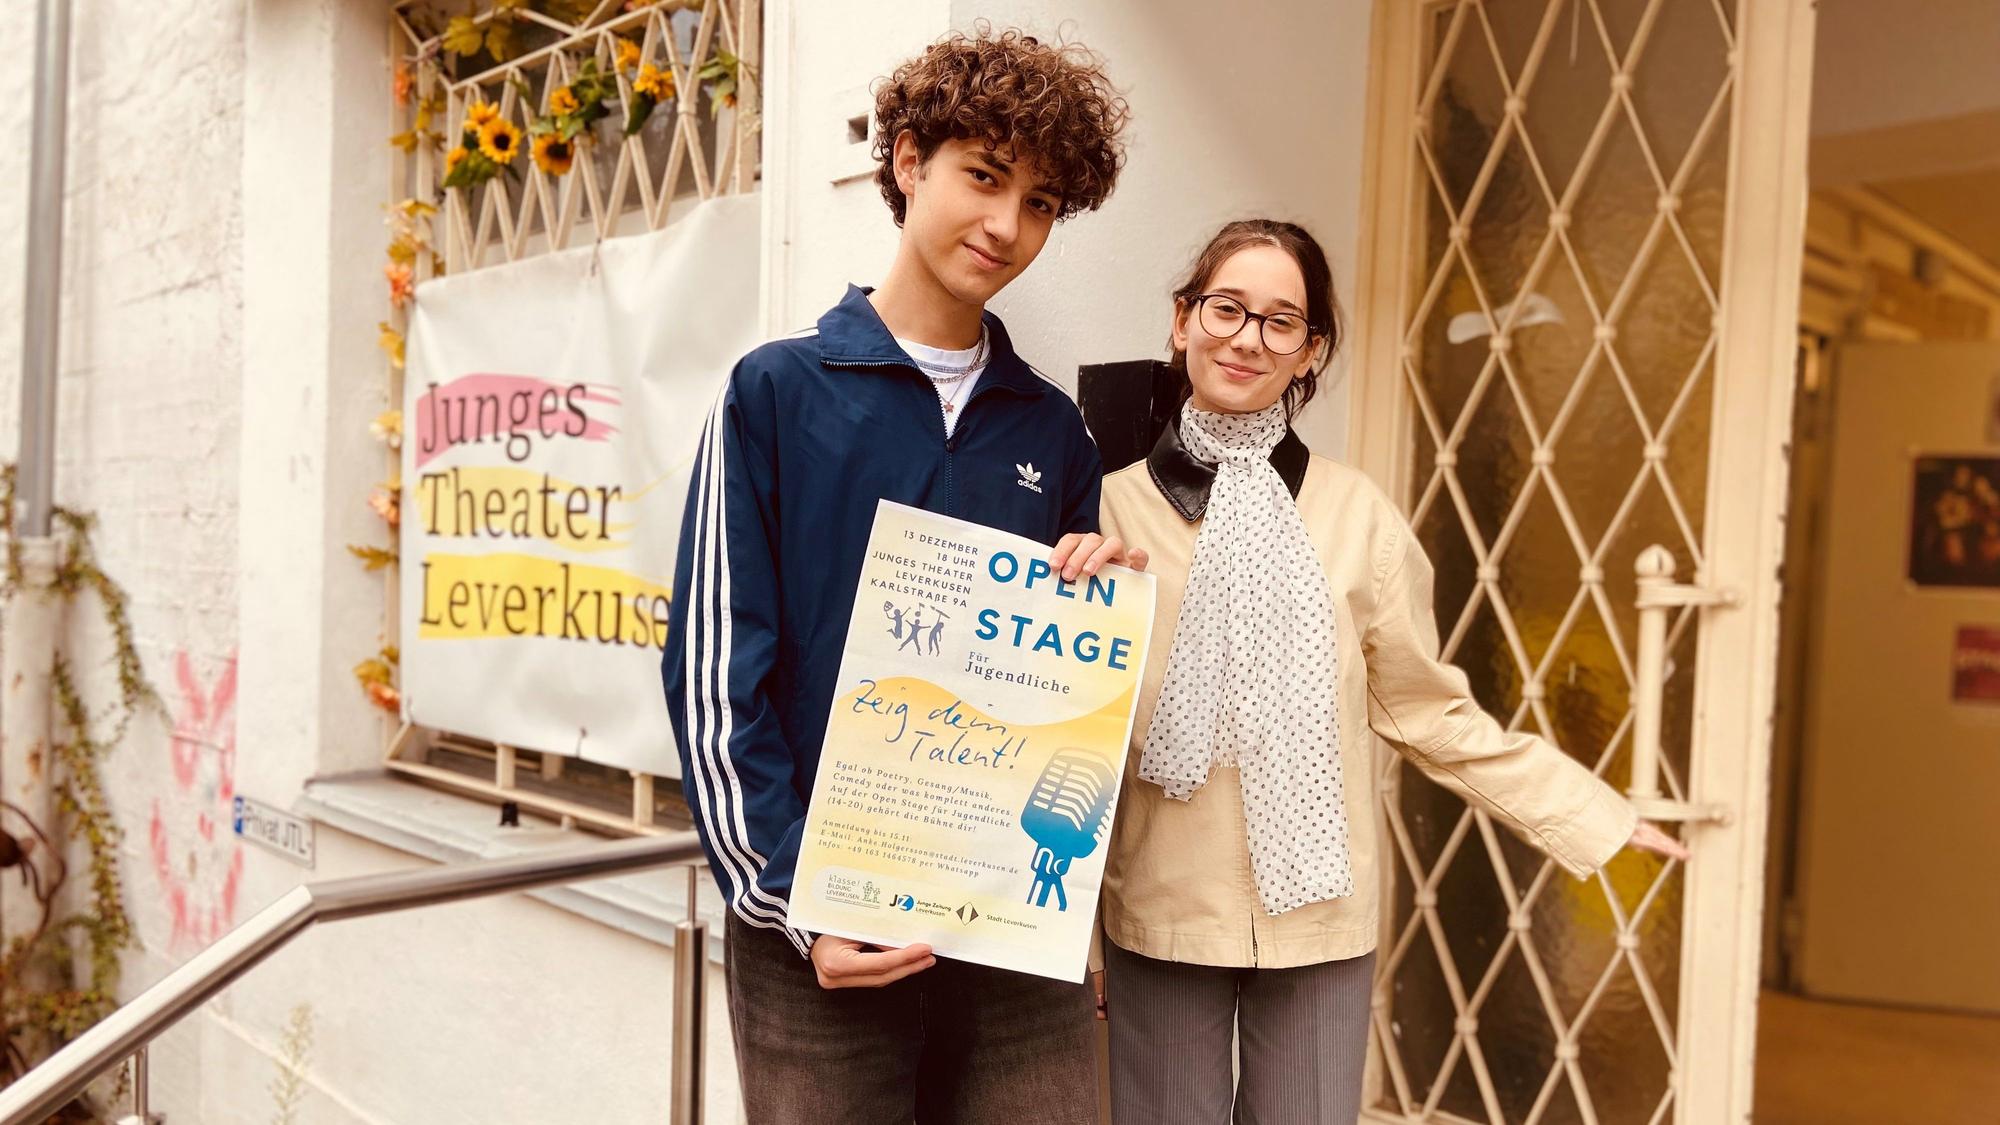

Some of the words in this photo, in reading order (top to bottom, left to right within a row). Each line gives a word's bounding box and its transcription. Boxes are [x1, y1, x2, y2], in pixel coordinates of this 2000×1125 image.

[422, 381, 588, 462] Junges
[1017, 479, 1043, 494] adidas
[421, 466, 623, 541] Theater
[904, 530, 915, 540] 13
[919, 534, 978, 556] DEZEMBER
[872, 551, 916, 568] JUNGES
[922, 562, 973, 582] THEATER
[937, 552, 948, 562] 18
[953, 557, 976, 569] UHR
[870, 578, 948, 603] KARLSTRAßE
[953, 597, 967, 608] 9A
[895, 570, 971, 595] LEVERKUSEN
[988, 551, 1116, 607] OPEN
[420, 561, 672, 653] Leverkuse
[975, 608, 1132, 671] STAGE
[968, 651, 990, 664] Für
[965, 661, 1071, 694] Jugendliche
[852, 679, 909, 743] Zeig
[928, 700, 1007, 735] dein
[910, 730, 1028, 770] Talent!
[833, 772, 872, 788] Comedy
[875, 782, 898, 792] oder
[902, 788, 920, 797] was
[923, 791, 968, 807] komplett
[972, 802, 1013, 817] anderes.
[835, 760, 858, 771] Egal
[861, 766, 873, 775] ob
[917, 777, 993, 801] Gesang/Musik,
[827, 796, 864, 812] (14-20)
[866, 806, 900, 817] gehört
[903, 811, 919, 821] die
[923, 815, 954, 828] Bühne
[957, 822, 977, 832] dir!
[830, 785, 848, 796] Auf
[851, 788, 868, 798] der
[872, 793, 897, 804] Open
[901, 798, 929, 812] Stage
[931, 805, 948, 815] für
[952, 809, 1011, 828] Jugendliche
[822, 819, 870, 835] Anmeldung
[873, 828, 886, 837] bis
[847, 845, 862, 854] +49
[919, 860, 933, 868] per
[937, 862, 980, 878] Whatsapp
[826, 890, 860, 900] LEVERKUSEN
[827, 883, 852, 893] BILDUNG
[828, 874, 861, 887] klasse!
[915, 907, 946, 918] Leverkusen
[916, 900, 932, 908] Junge
[932, 902, 952, 912] Zeitung
[986, 914, 1002, 922] Stadt
[1003, 917, 1038, 930] Leverkusen
